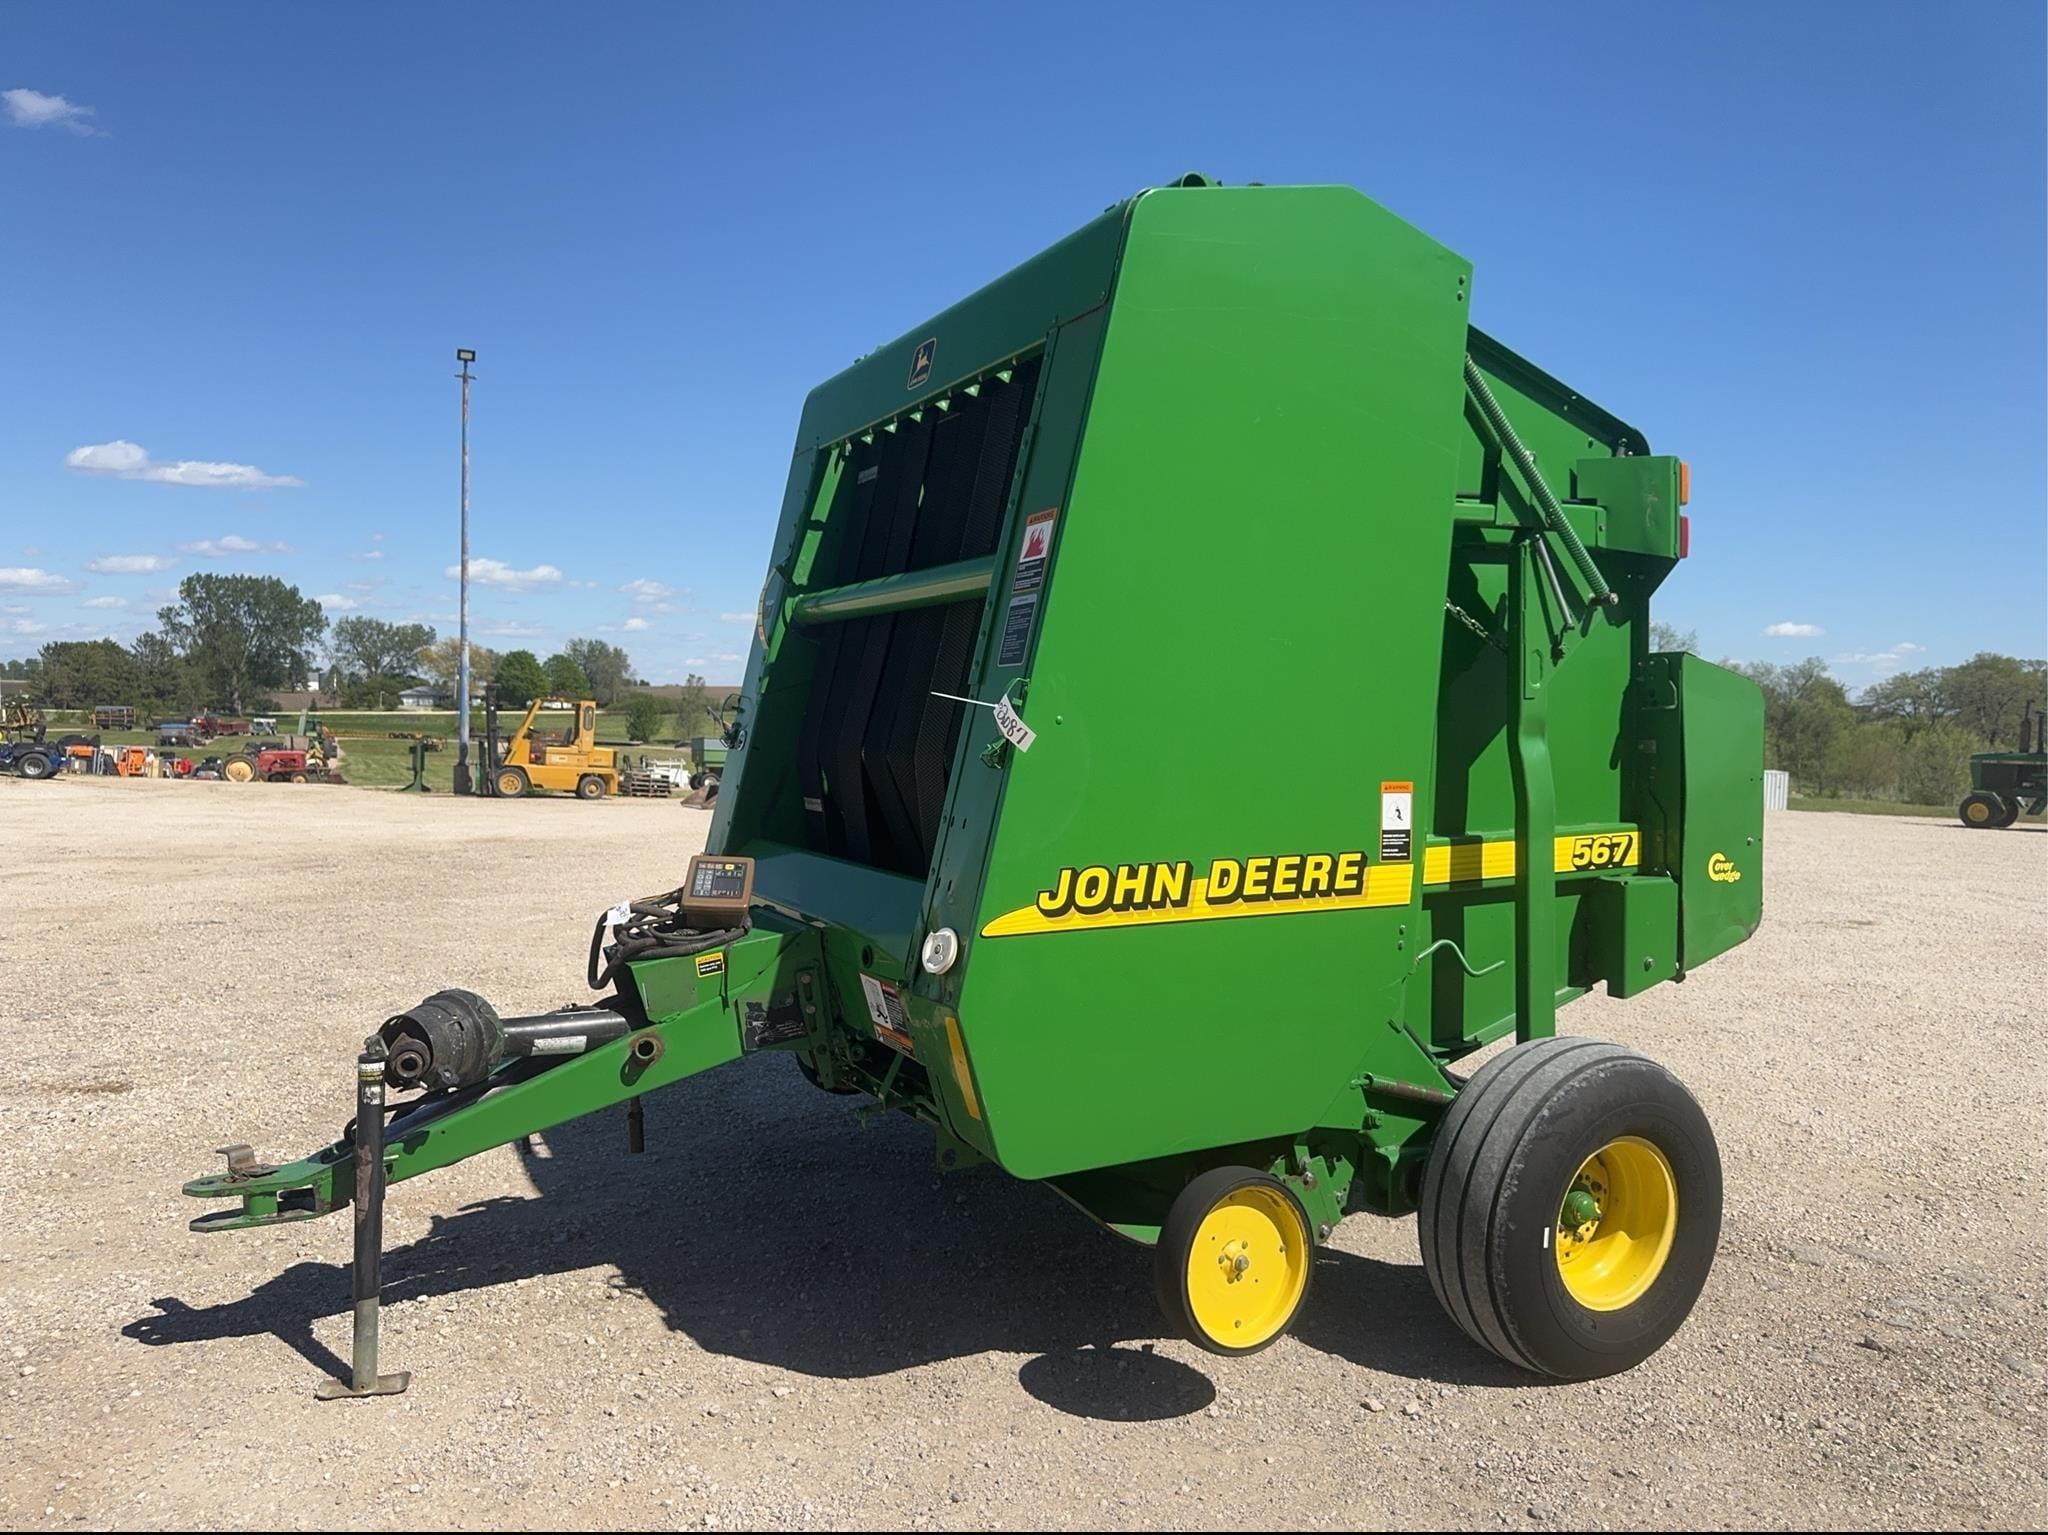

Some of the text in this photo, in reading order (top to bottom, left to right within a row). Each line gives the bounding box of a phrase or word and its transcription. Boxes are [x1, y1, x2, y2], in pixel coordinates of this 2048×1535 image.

[1572, 835, 1633, 871] 567
[1036, 852, 1367, 918] JOHN DEERE
